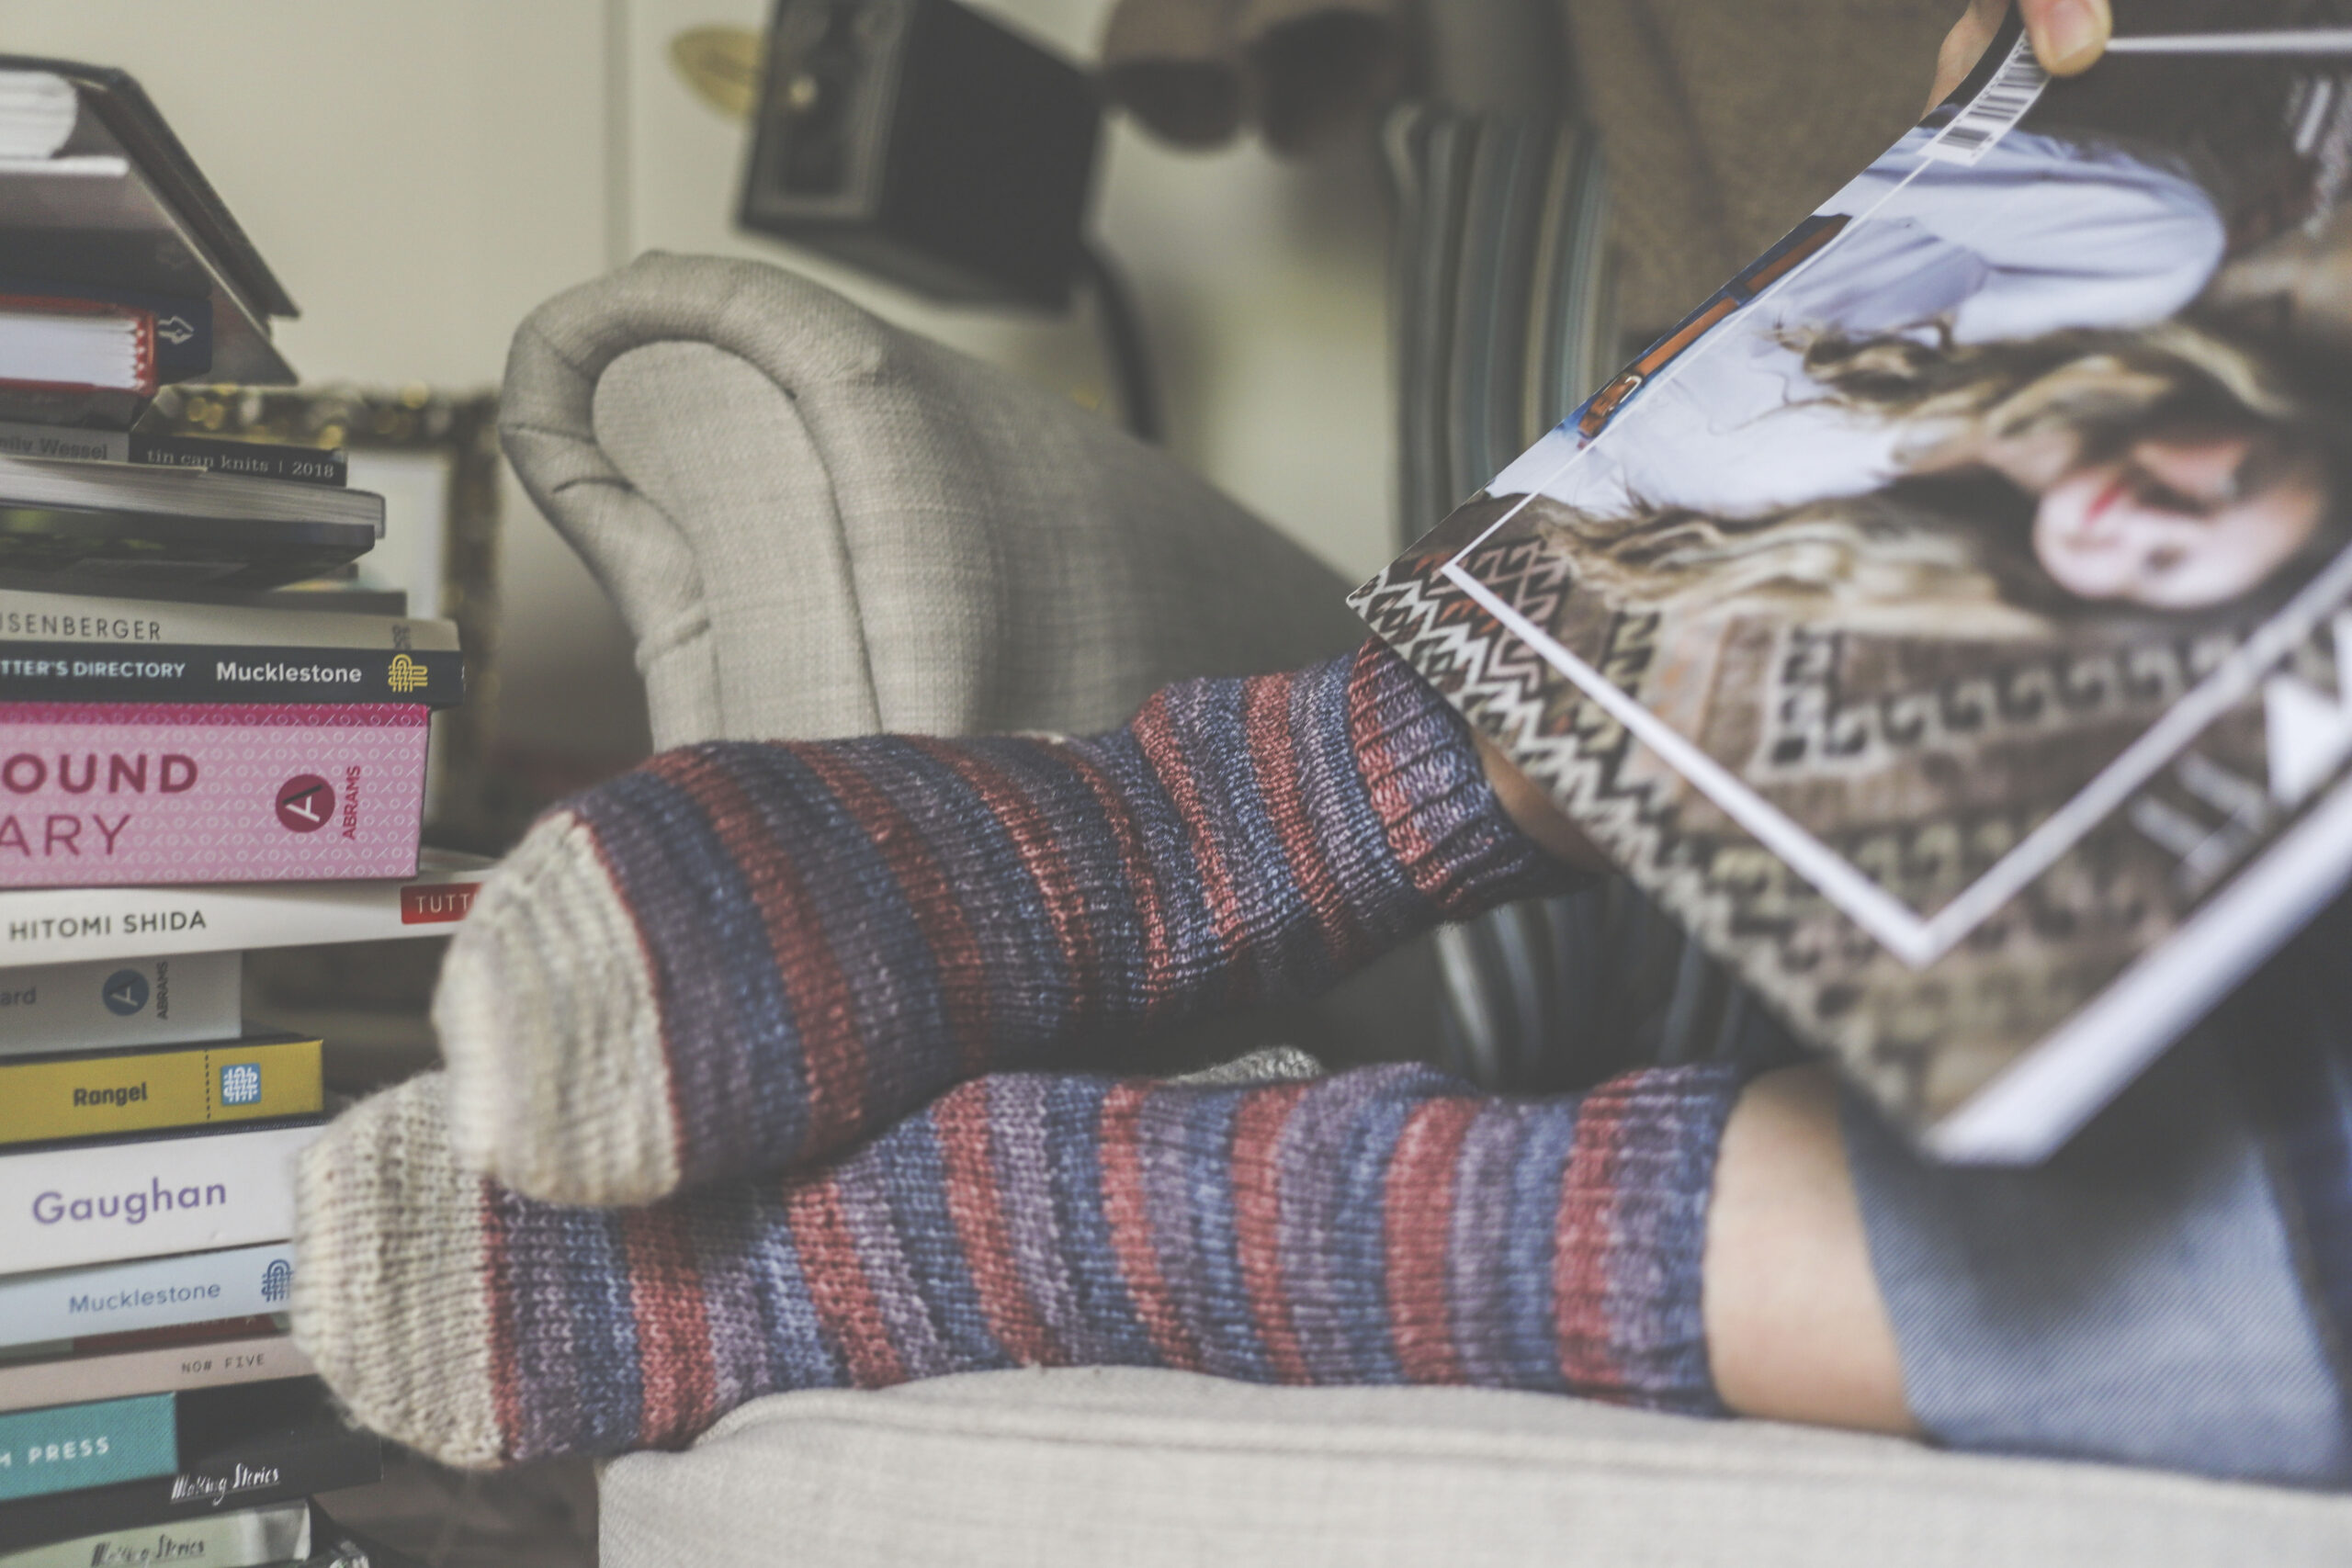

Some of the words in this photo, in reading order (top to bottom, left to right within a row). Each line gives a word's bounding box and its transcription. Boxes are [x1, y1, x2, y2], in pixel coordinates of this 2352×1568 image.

[40, 439, 107, 460] Wessel
[147, 448, 175, 465] tin
[181, 453, 214, 468] can
[220, 453, 269, 473] knits
[292, 461, 334, 479] 2018
[74, 661, 187, 679] DIRECTORY
[216, 661, 362, 684] Mucklestone
[2, 753, 198, 794] OUND
[343, 765, 360, 840] ABRAMS
[0, 814, 130, 856] ARY
[415, 893, 475, 915] TUTT
[9, 917, 112, 941] HITOMI
[124, 909, 207, 934] SHIDA
[156, 961, 168, 1020] ABRAMS
[74, 1082, 148, 1108] Rangel
[33, 1177, 226, 1225] Gaughan
[69, 1280, 220, 1314] Mucklestone
[181, 1359, 213, 1373] NO#
[224, 1354, 265, 1370] FIVE
[28, 1436, 109, 1465] PRESS
[233, 1462, 280, 1489] Stories
